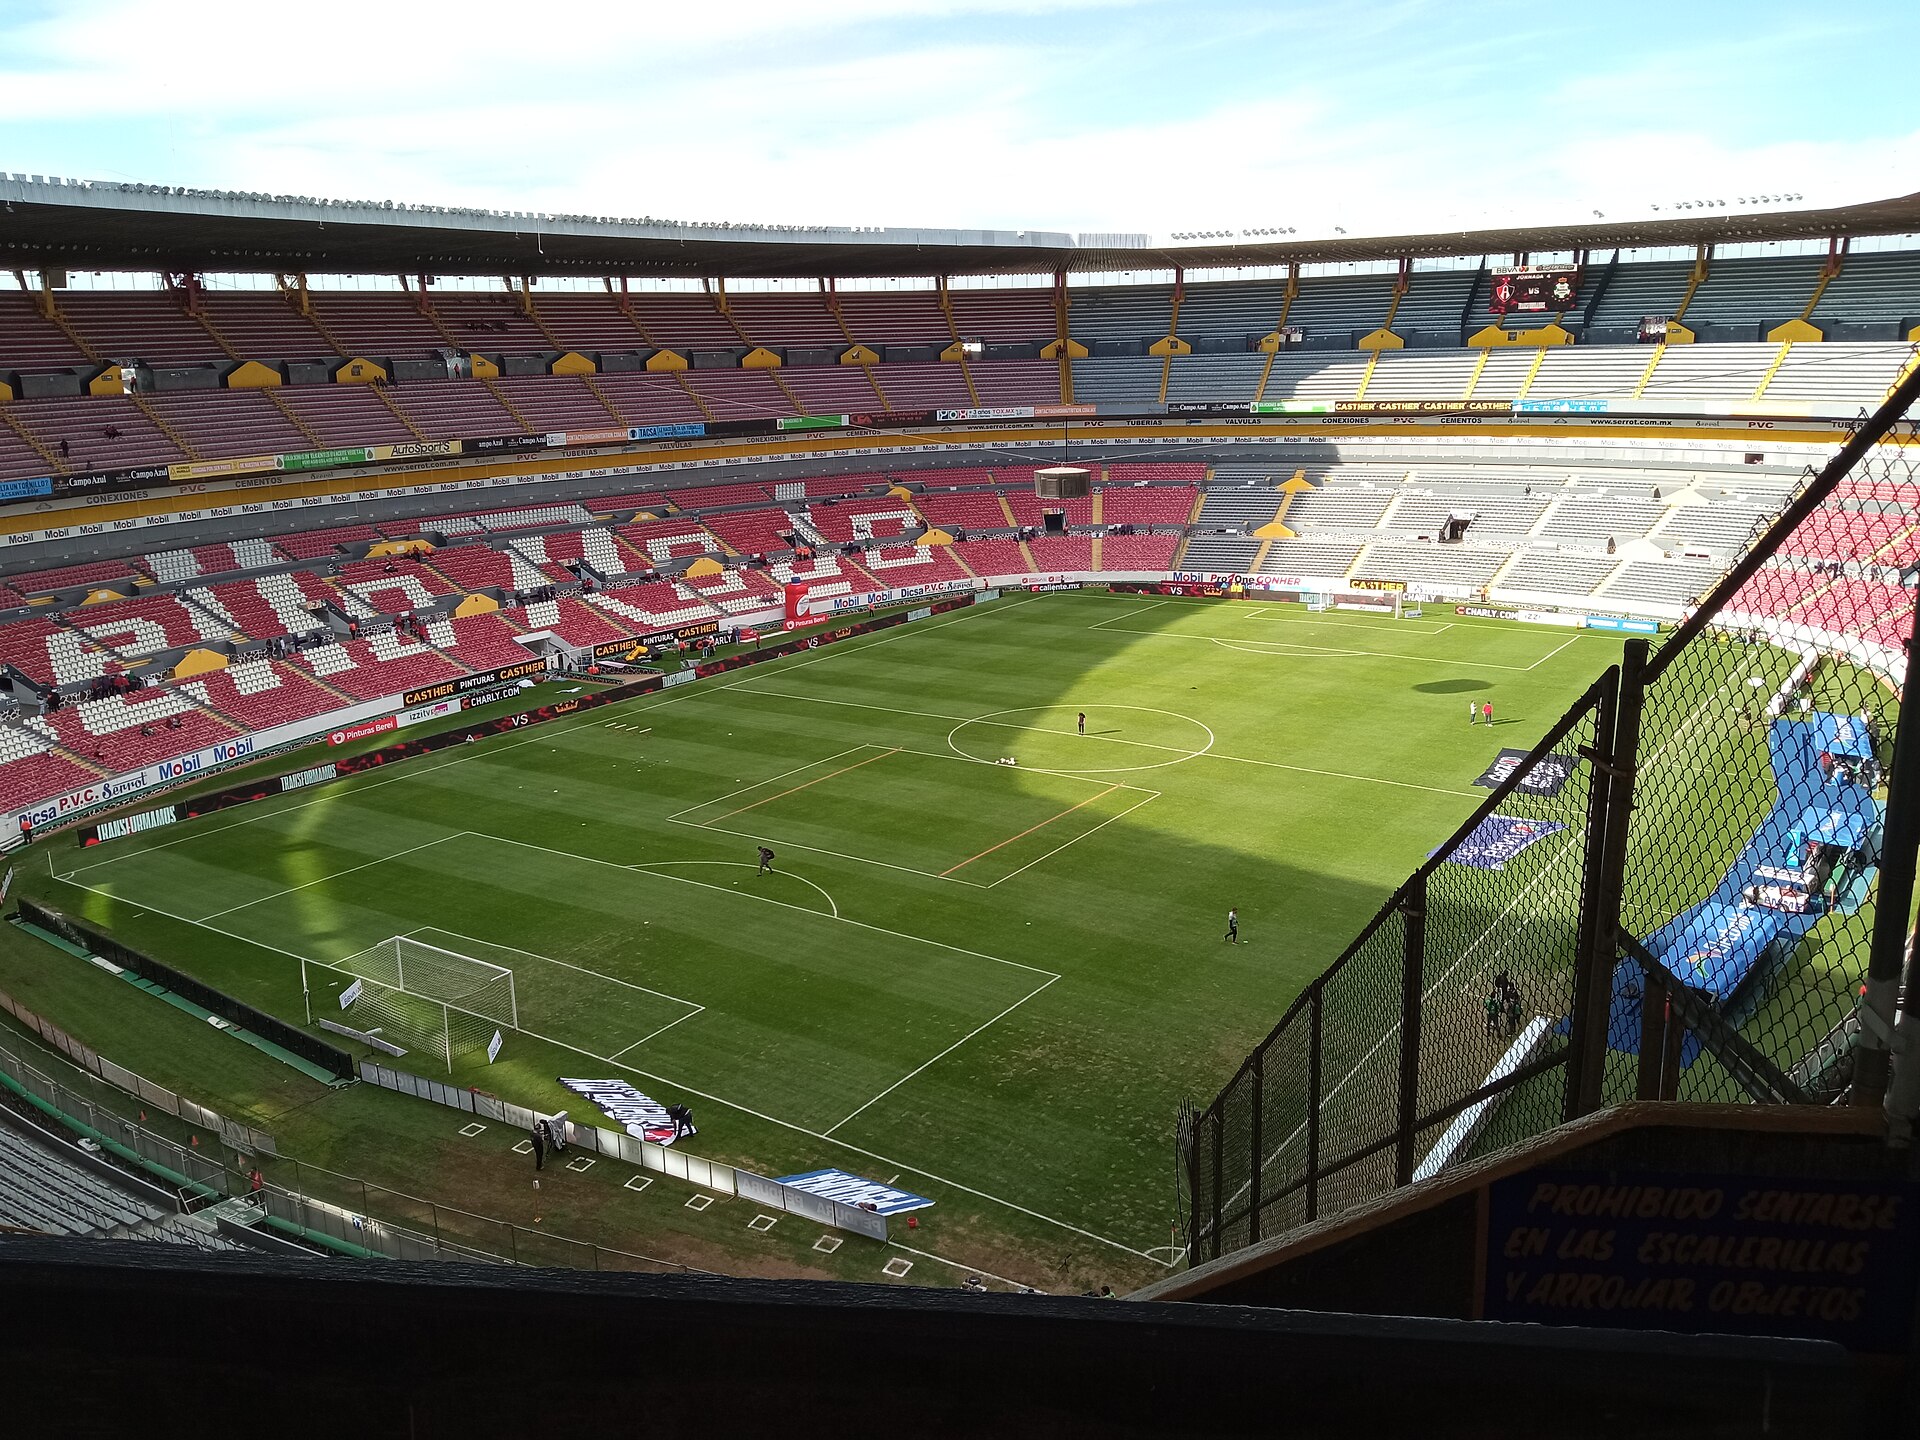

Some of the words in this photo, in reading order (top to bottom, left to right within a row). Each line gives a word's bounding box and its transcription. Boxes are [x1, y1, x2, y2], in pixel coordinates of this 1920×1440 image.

[1424, 402, 1465, 410] CASTHER
[640, 427, 658, 437] TACSA
[69, 477, 91, 486] Campo
[92, 476, 106, 484] Azul
[86, 491, 148, 504] CONEXIONES
[179, 485, 206, 494] PVC
[235, 477, 282, 487] CEMENTOS
[384, 460, 460, 472] www.serrot.com.mx
[562, 449, 598, 457] TUBERIAS
[131, 470, 153, 479] Campo
[154, 468, 167, 477] Azul
[9, 533, 33, 544] Mobil
[45, 529, 69, 539] Mobil
[80, 524, 103, 534] Mobil
[114, 520, 136, 529] Mobil
[147, 515, 169, 525] Mobil
[179, 511, 200, 521] Mobil
[211, 508, 232, 517] Mobil
[242, 504, 263, 513] Mobil
[273, 501, 292, 509] Mobil
[302, 497, 322, 506] Mobil
[331, 495, 350, 503] Mobil
[441, 483, 459, 491] Mobil
[492, 478, 509, 486] Mobil
[1040, 583, 1080, 591] caliente.mx
[1173, 572, 1203, 582] Mobil
[1257, 576, 1300, 585] GONHER
[1351, 581, 1404, 591] CASTHER
[834, 596, 859, 608] Mobil
[867, 591, 892, 603] Mobil
[901, 587, 923, 597] Dicsa
[924, 583, 947, 592] P.V.C.
[1403, 594, 1436, 602] CHARLY
[1466, 607, 1518, 620] CHARLY.COM
[795, 619, 812, 627] Pinturas
[596, 641, 637, 656] CASTHER
[643, 633, 674, 645] PINTURAS
[678, 623, 717, 637] CASTHER
[807, 638, 818, 646] VS
[405, 684, 454, 704] CASTHER
[460, 674, 495, 689] PINTURAS
[500, 660, 545, 679] CASTHER
[471, 687, 520, 707] CHARLY.COM
[512, 715, 529, 726] VS
[347, 727, 374, 739] Pinturas
[376, 721, 393, 731] Berel
[59, 789, 98, 811] P.V.C.
[102, 772, 147, 799] Serrot
[159, 753, 200, 780] Mobil
[214, 738, 253, 762] Mobil
[280, 764, 337, 792] TRANSFORMAMOS
[97, 806, 176, 841] TRANSFORMAMOS
[1527, 1183, 1724, 1219] PROHIBIDO
[1733, 1190, 1902, 1230] SENTARSE
[1504, 1227, 1550, 1258] EN
[1556, 1229, 1616, 1261] LAS
[1637, 1232, 1869, 1275] ESCALERILLAS
[1506, 1272, 1526, 1302] Y
[1526, 1272, 1695, 1312] ARROJAR
[1708, 1281, 1866, 1321] OBJETOS
